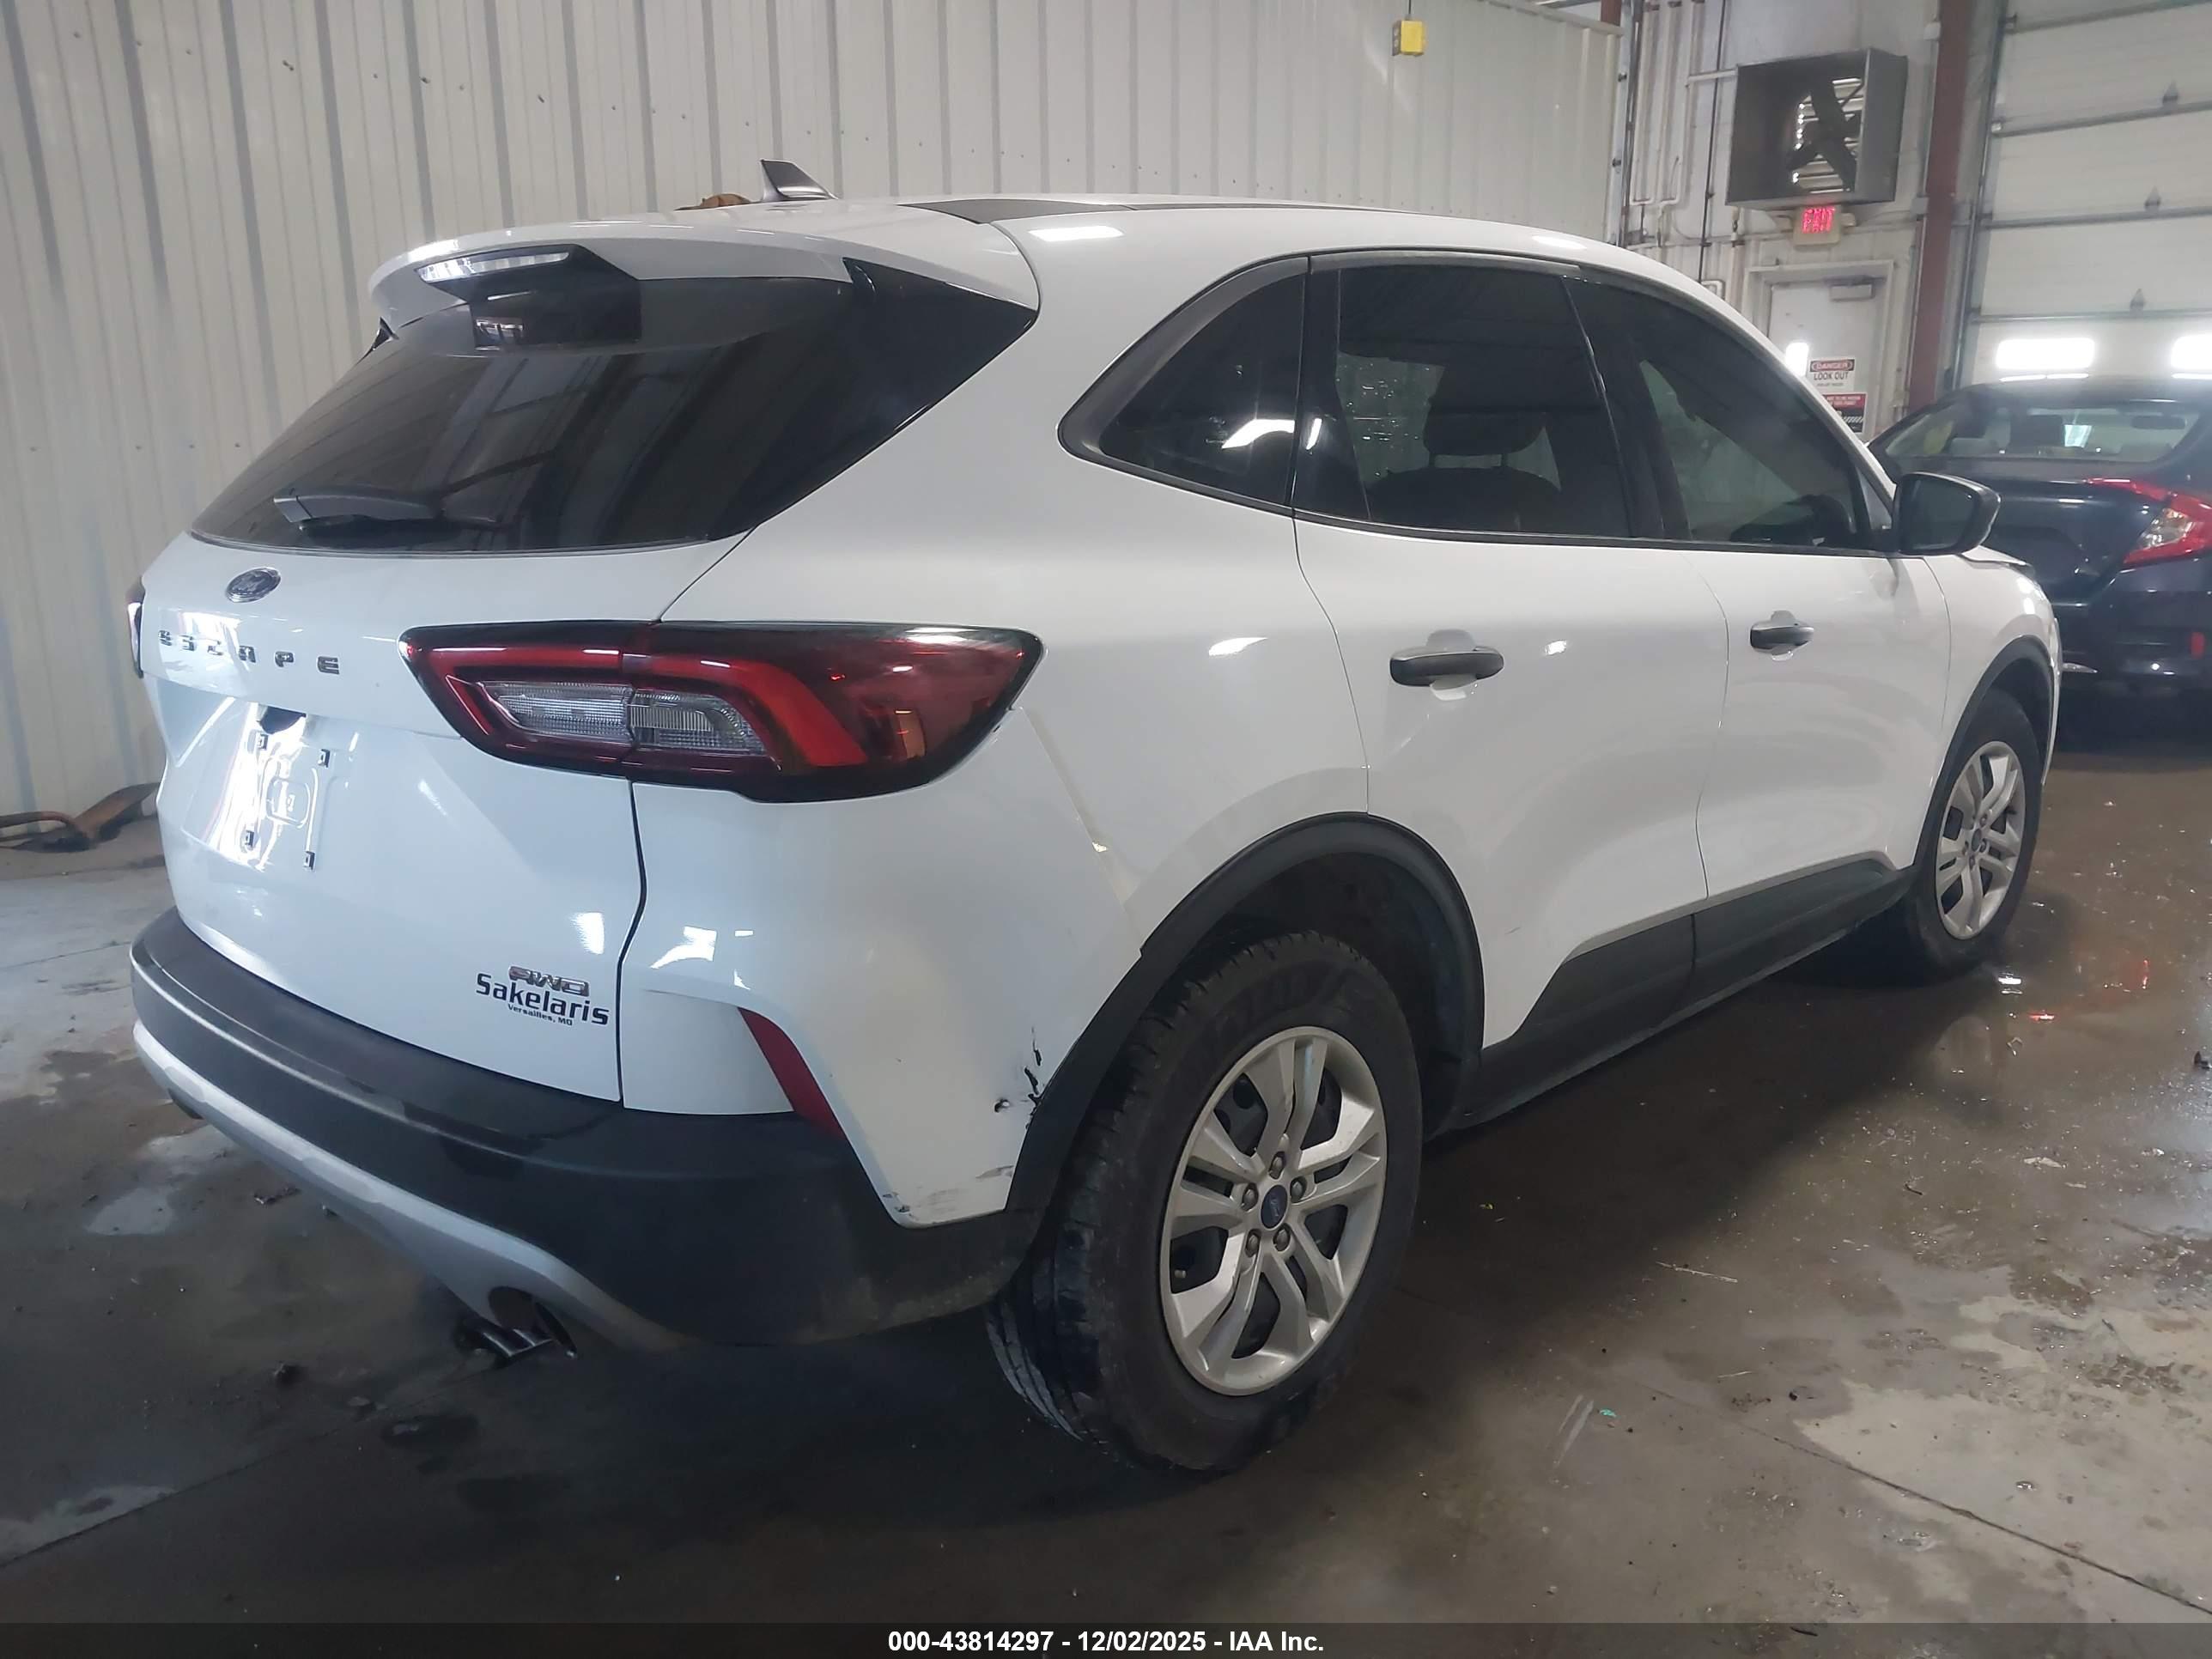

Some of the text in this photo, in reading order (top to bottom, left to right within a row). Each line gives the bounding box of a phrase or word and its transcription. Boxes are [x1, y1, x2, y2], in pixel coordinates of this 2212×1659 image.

[1803, 208, 1835, 233] EXIT
[1814, 371, 1849, 380] LOOK OUT
[476, 972, 610, 1025] Sakelaris
[508, 1003, 573, 1026] Versailles, MO
